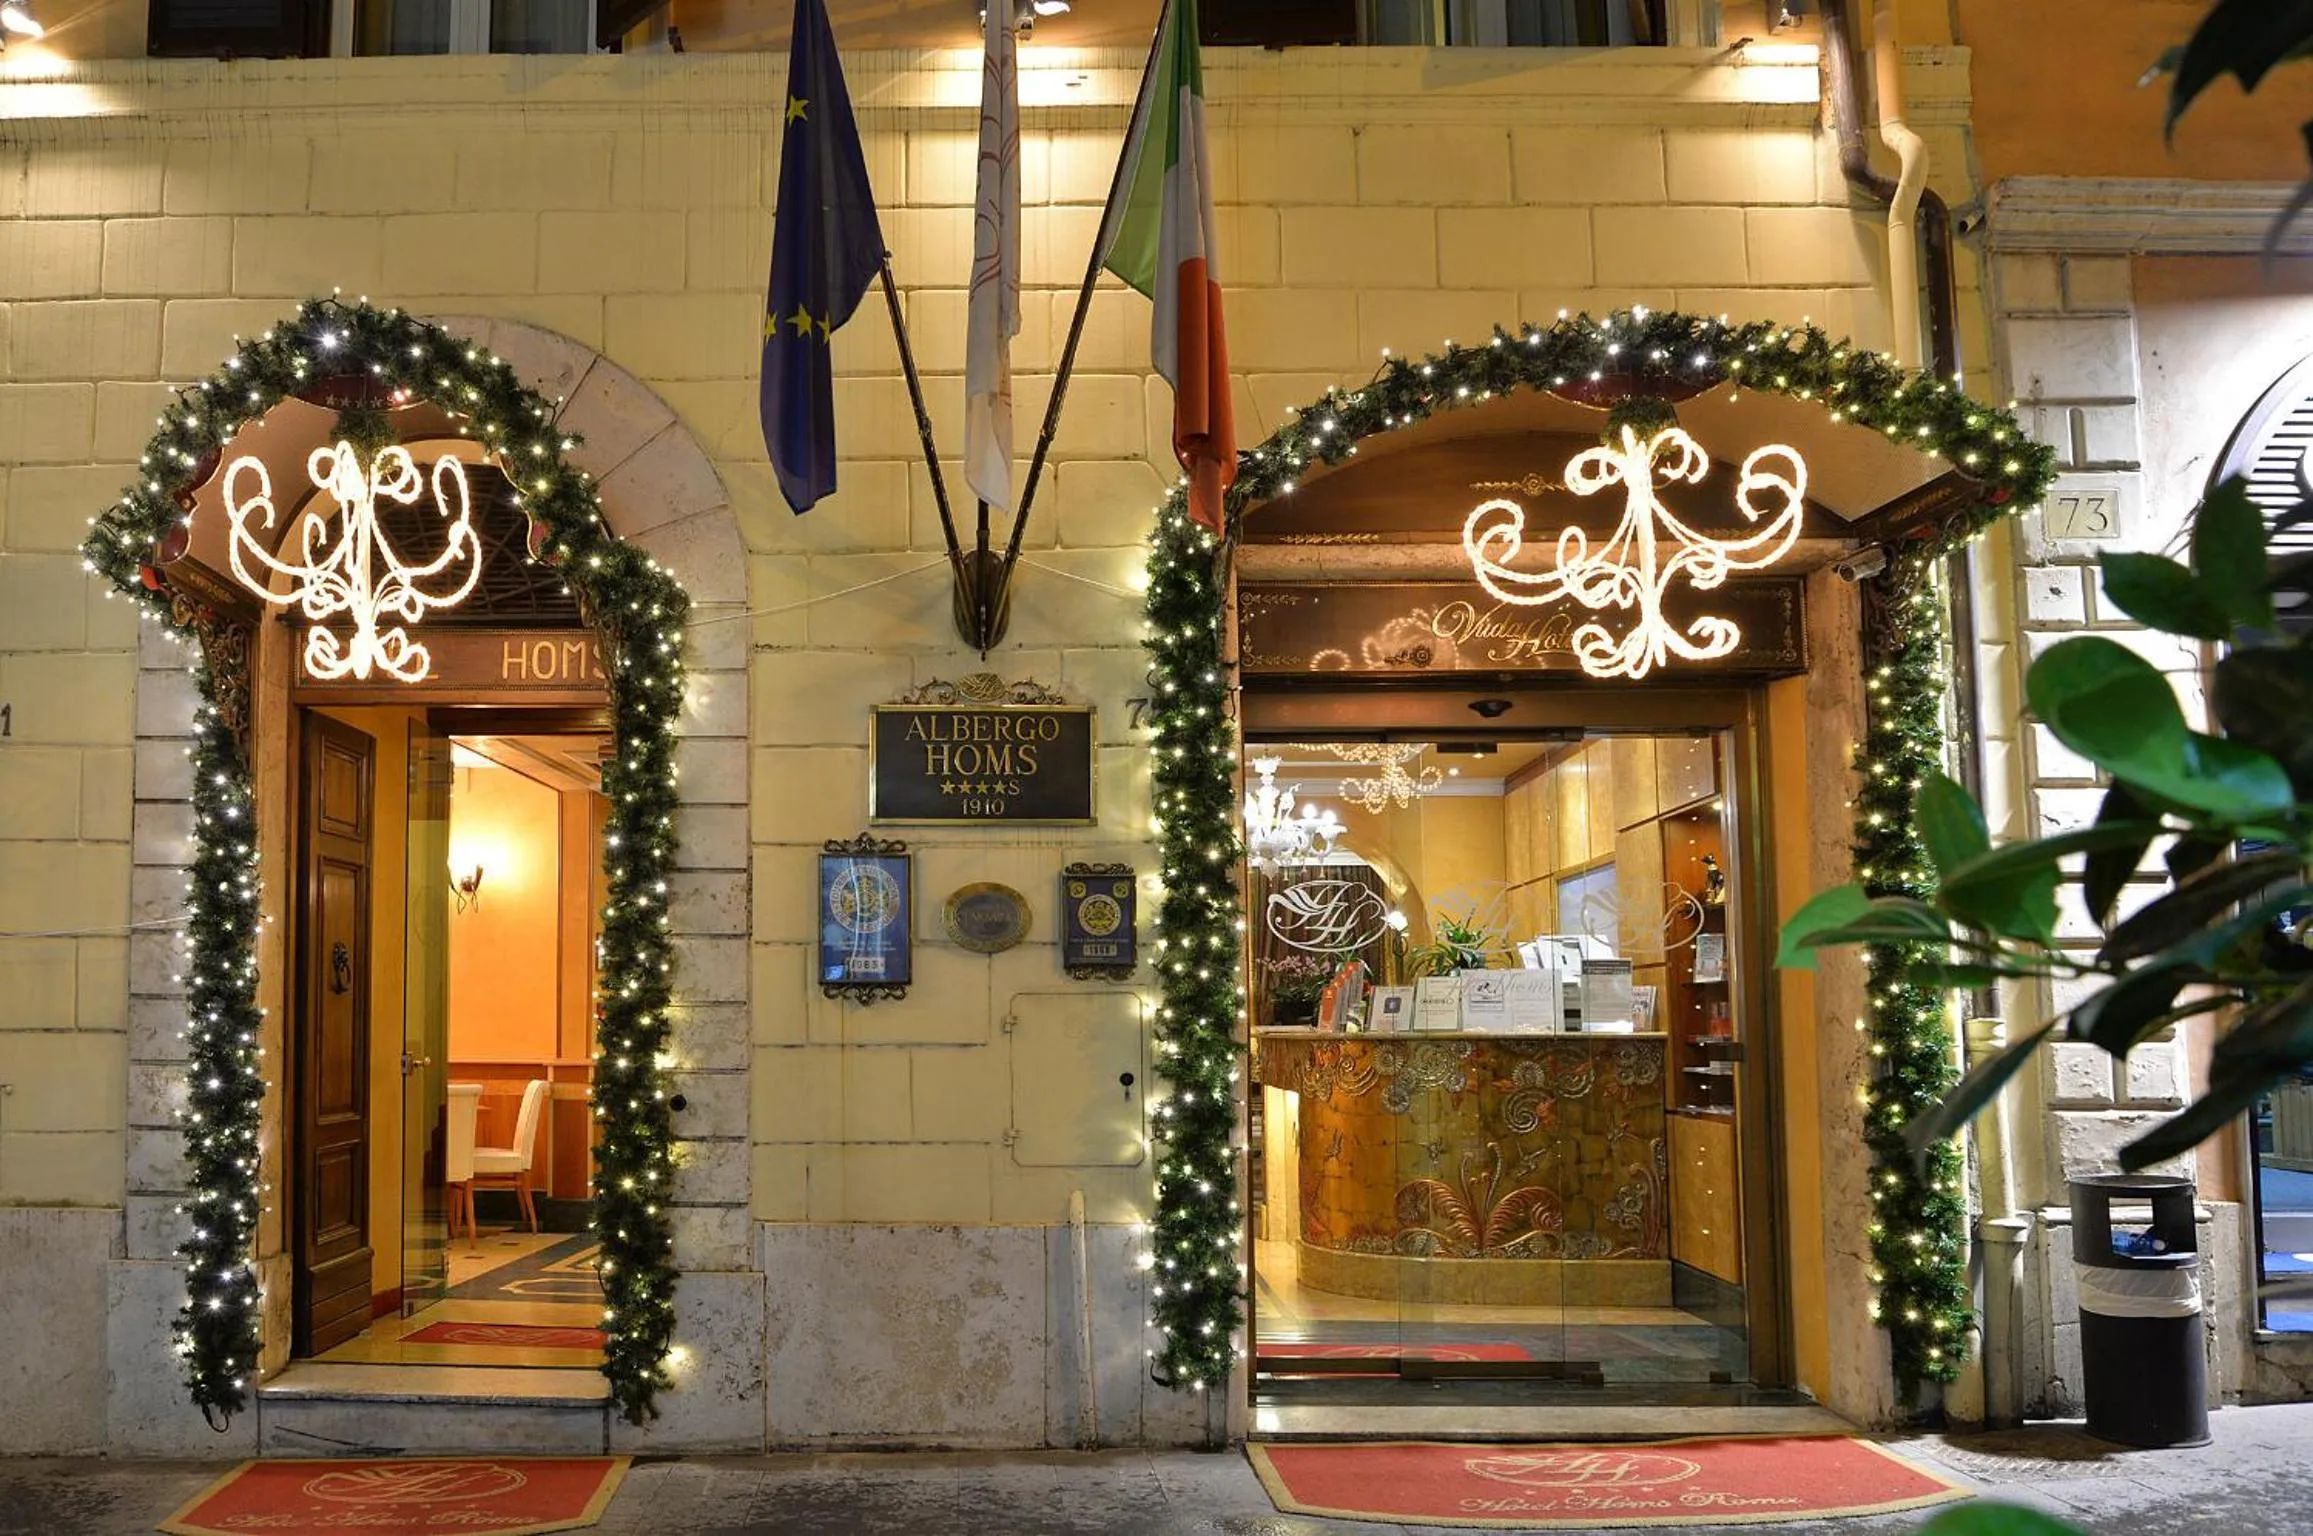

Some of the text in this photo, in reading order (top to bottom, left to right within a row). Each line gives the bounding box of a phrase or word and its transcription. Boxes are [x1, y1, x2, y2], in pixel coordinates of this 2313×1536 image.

[2058, 497, 2108, 536] 73
[904, 715, 1060, 742] ALBERGO
[924, 744, 1038, 776] HOMS
[961, 799, 1005, 816] 1910
